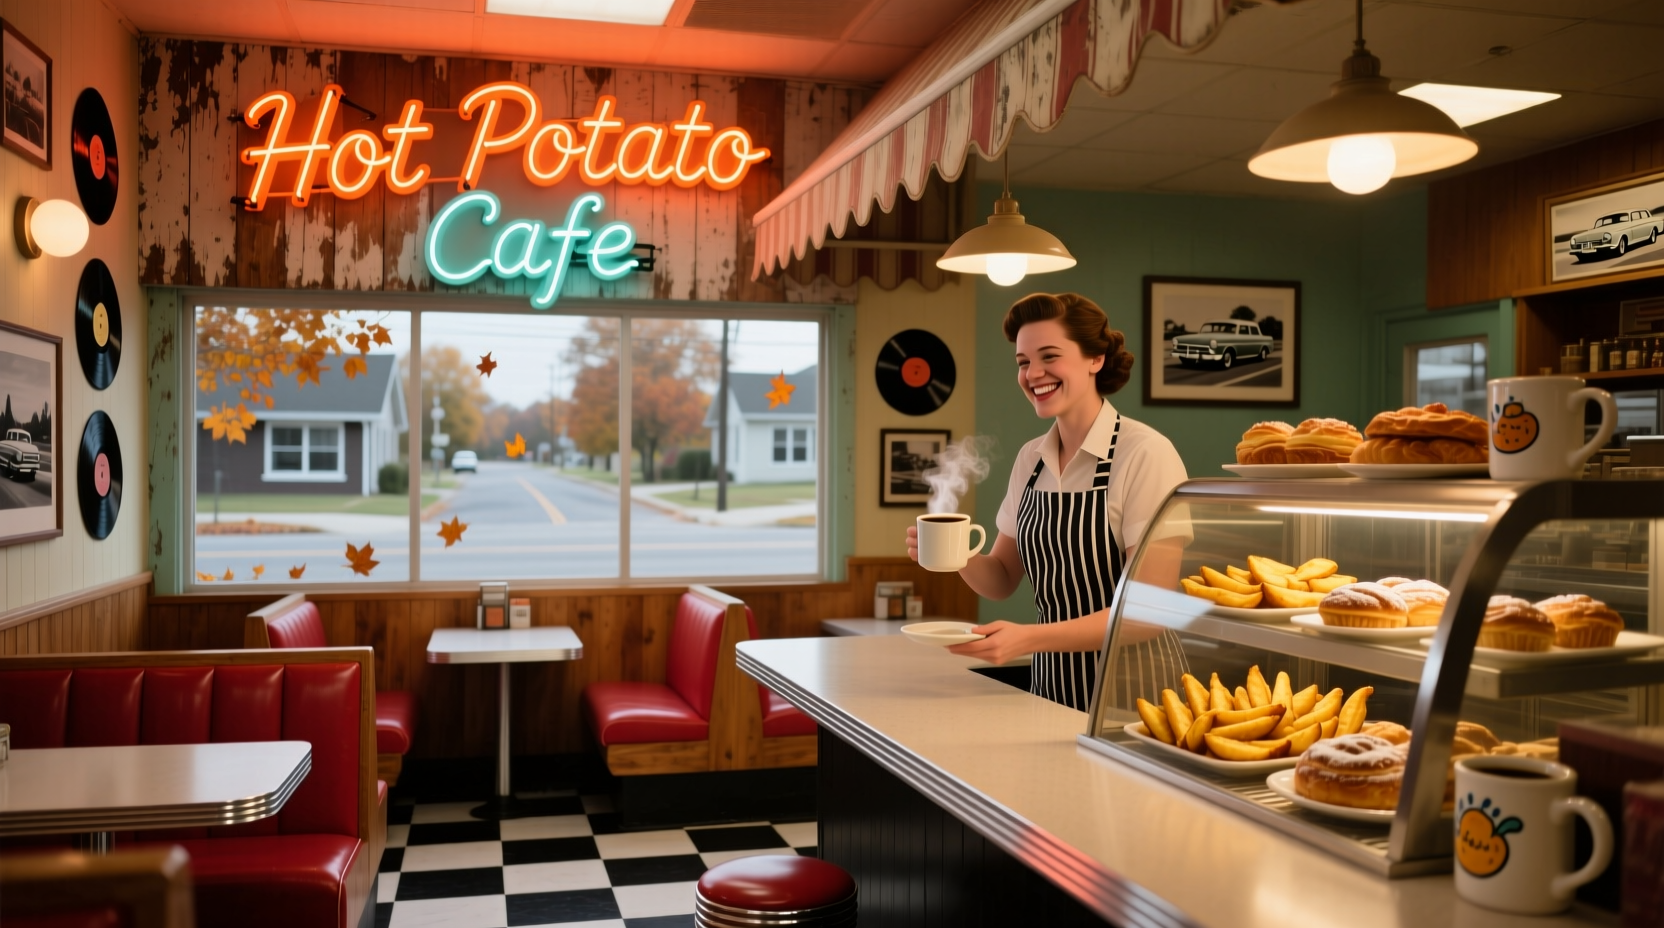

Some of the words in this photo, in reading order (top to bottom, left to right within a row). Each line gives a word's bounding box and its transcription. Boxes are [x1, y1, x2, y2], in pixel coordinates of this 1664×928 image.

[242, 83, 431, 211] Hot
[458, 81, 771, 192] Potato
[425, 190, 640, 309] Cafe
